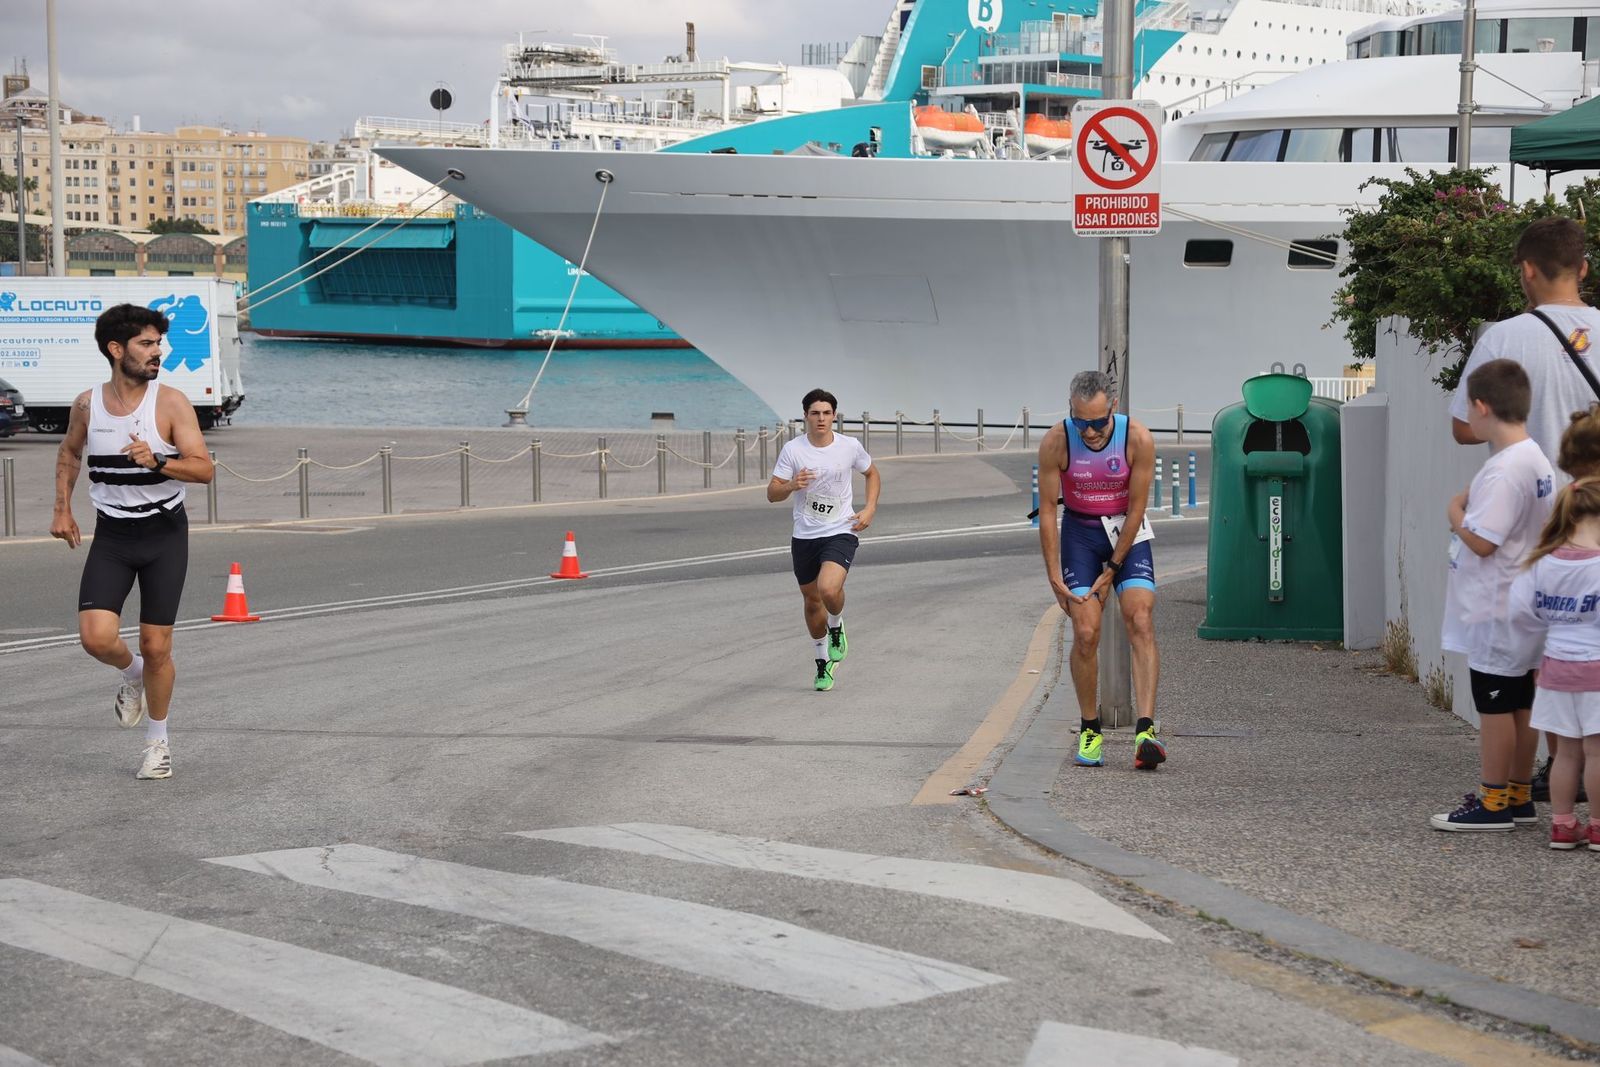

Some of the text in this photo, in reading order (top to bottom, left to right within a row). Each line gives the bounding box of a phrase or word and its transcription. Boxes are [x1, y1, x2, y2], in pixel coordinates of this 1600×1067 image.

[1085, 196, 1149, 209] PROHIBIDO
[1076, 211, 1158, 226] USAR DRONES
[18, 300, 102, 311] LOCAUTO
[812, 501, 834, 514] 887
[1271, 498, 1281, 589] ecovidrio
